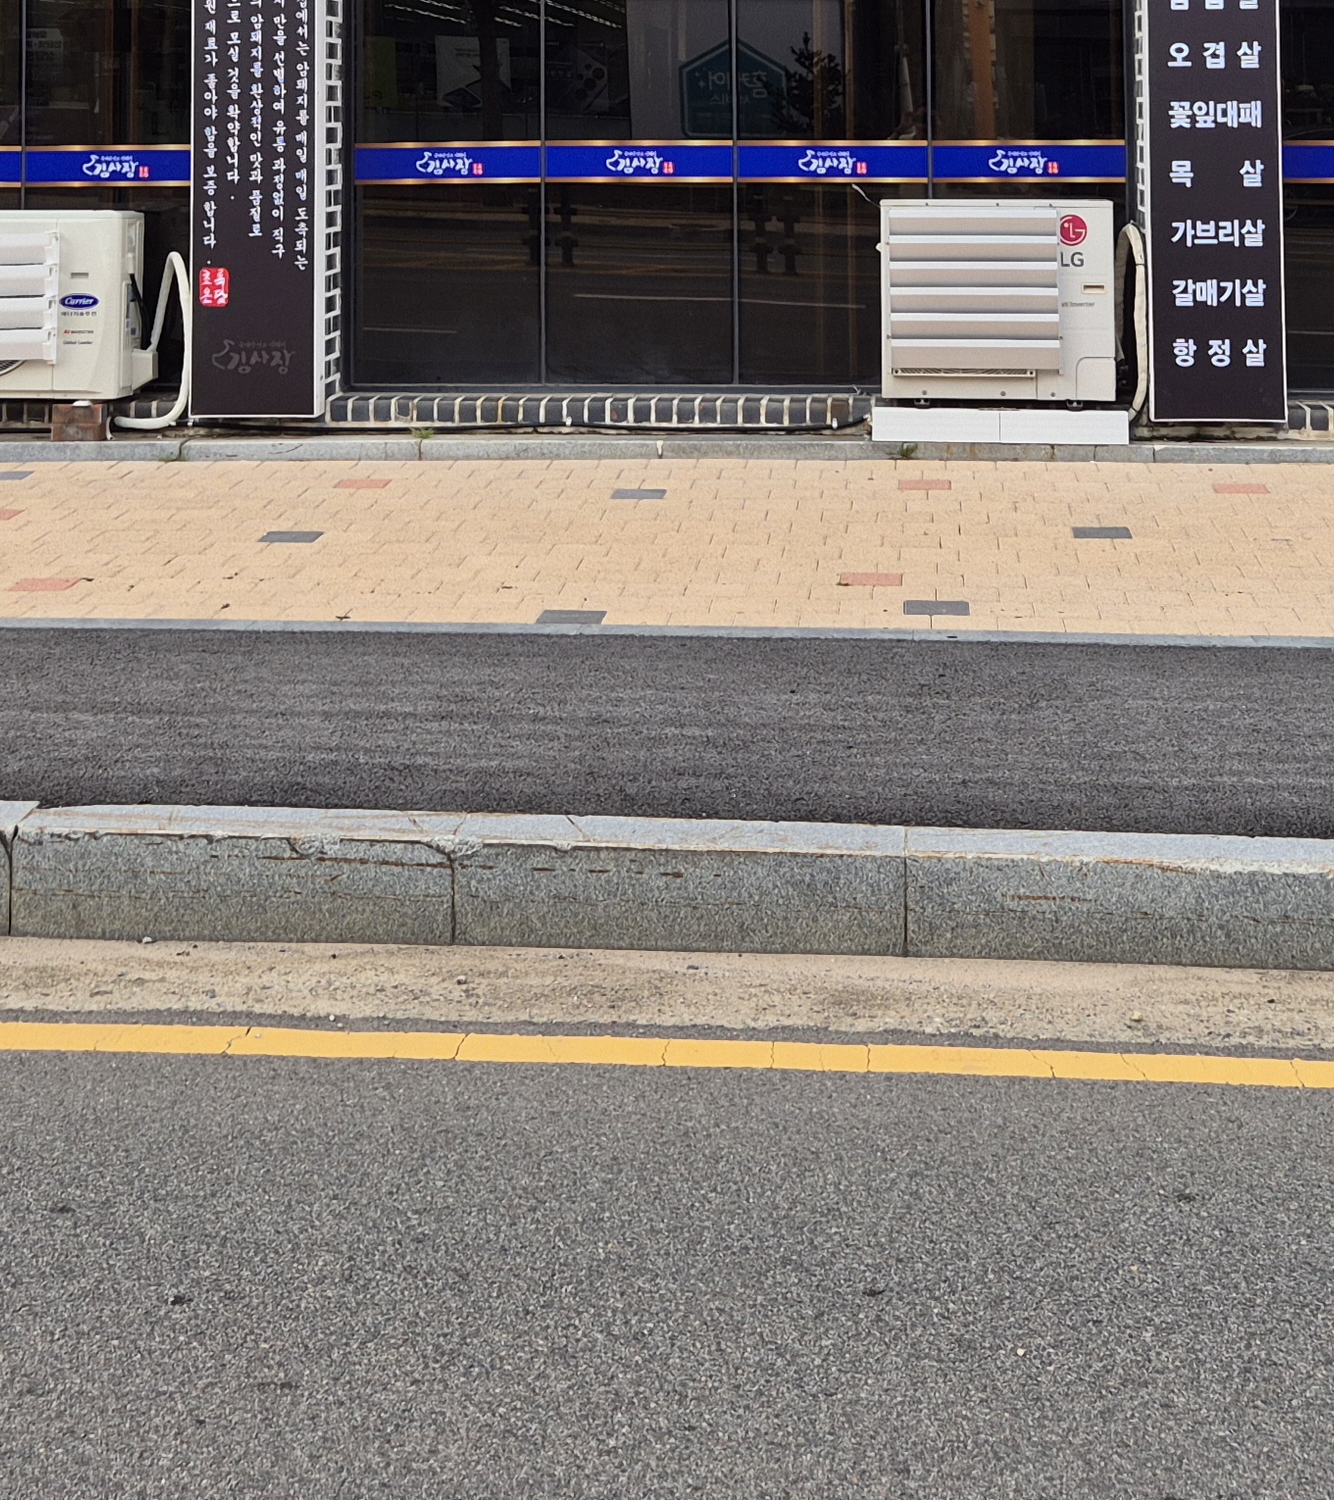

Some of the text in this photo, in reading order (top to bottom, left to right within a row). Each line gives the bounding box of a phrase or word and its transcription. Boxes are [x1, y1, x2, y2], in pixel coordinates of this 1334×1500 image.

[1168, 100, 1263, 129] 꽃잎대패
[1171, 219, 1266, 247] 가브리살
[1060, 251, 1084, 267] LG
[1171, 279, 1266, 307] 갈매기살
